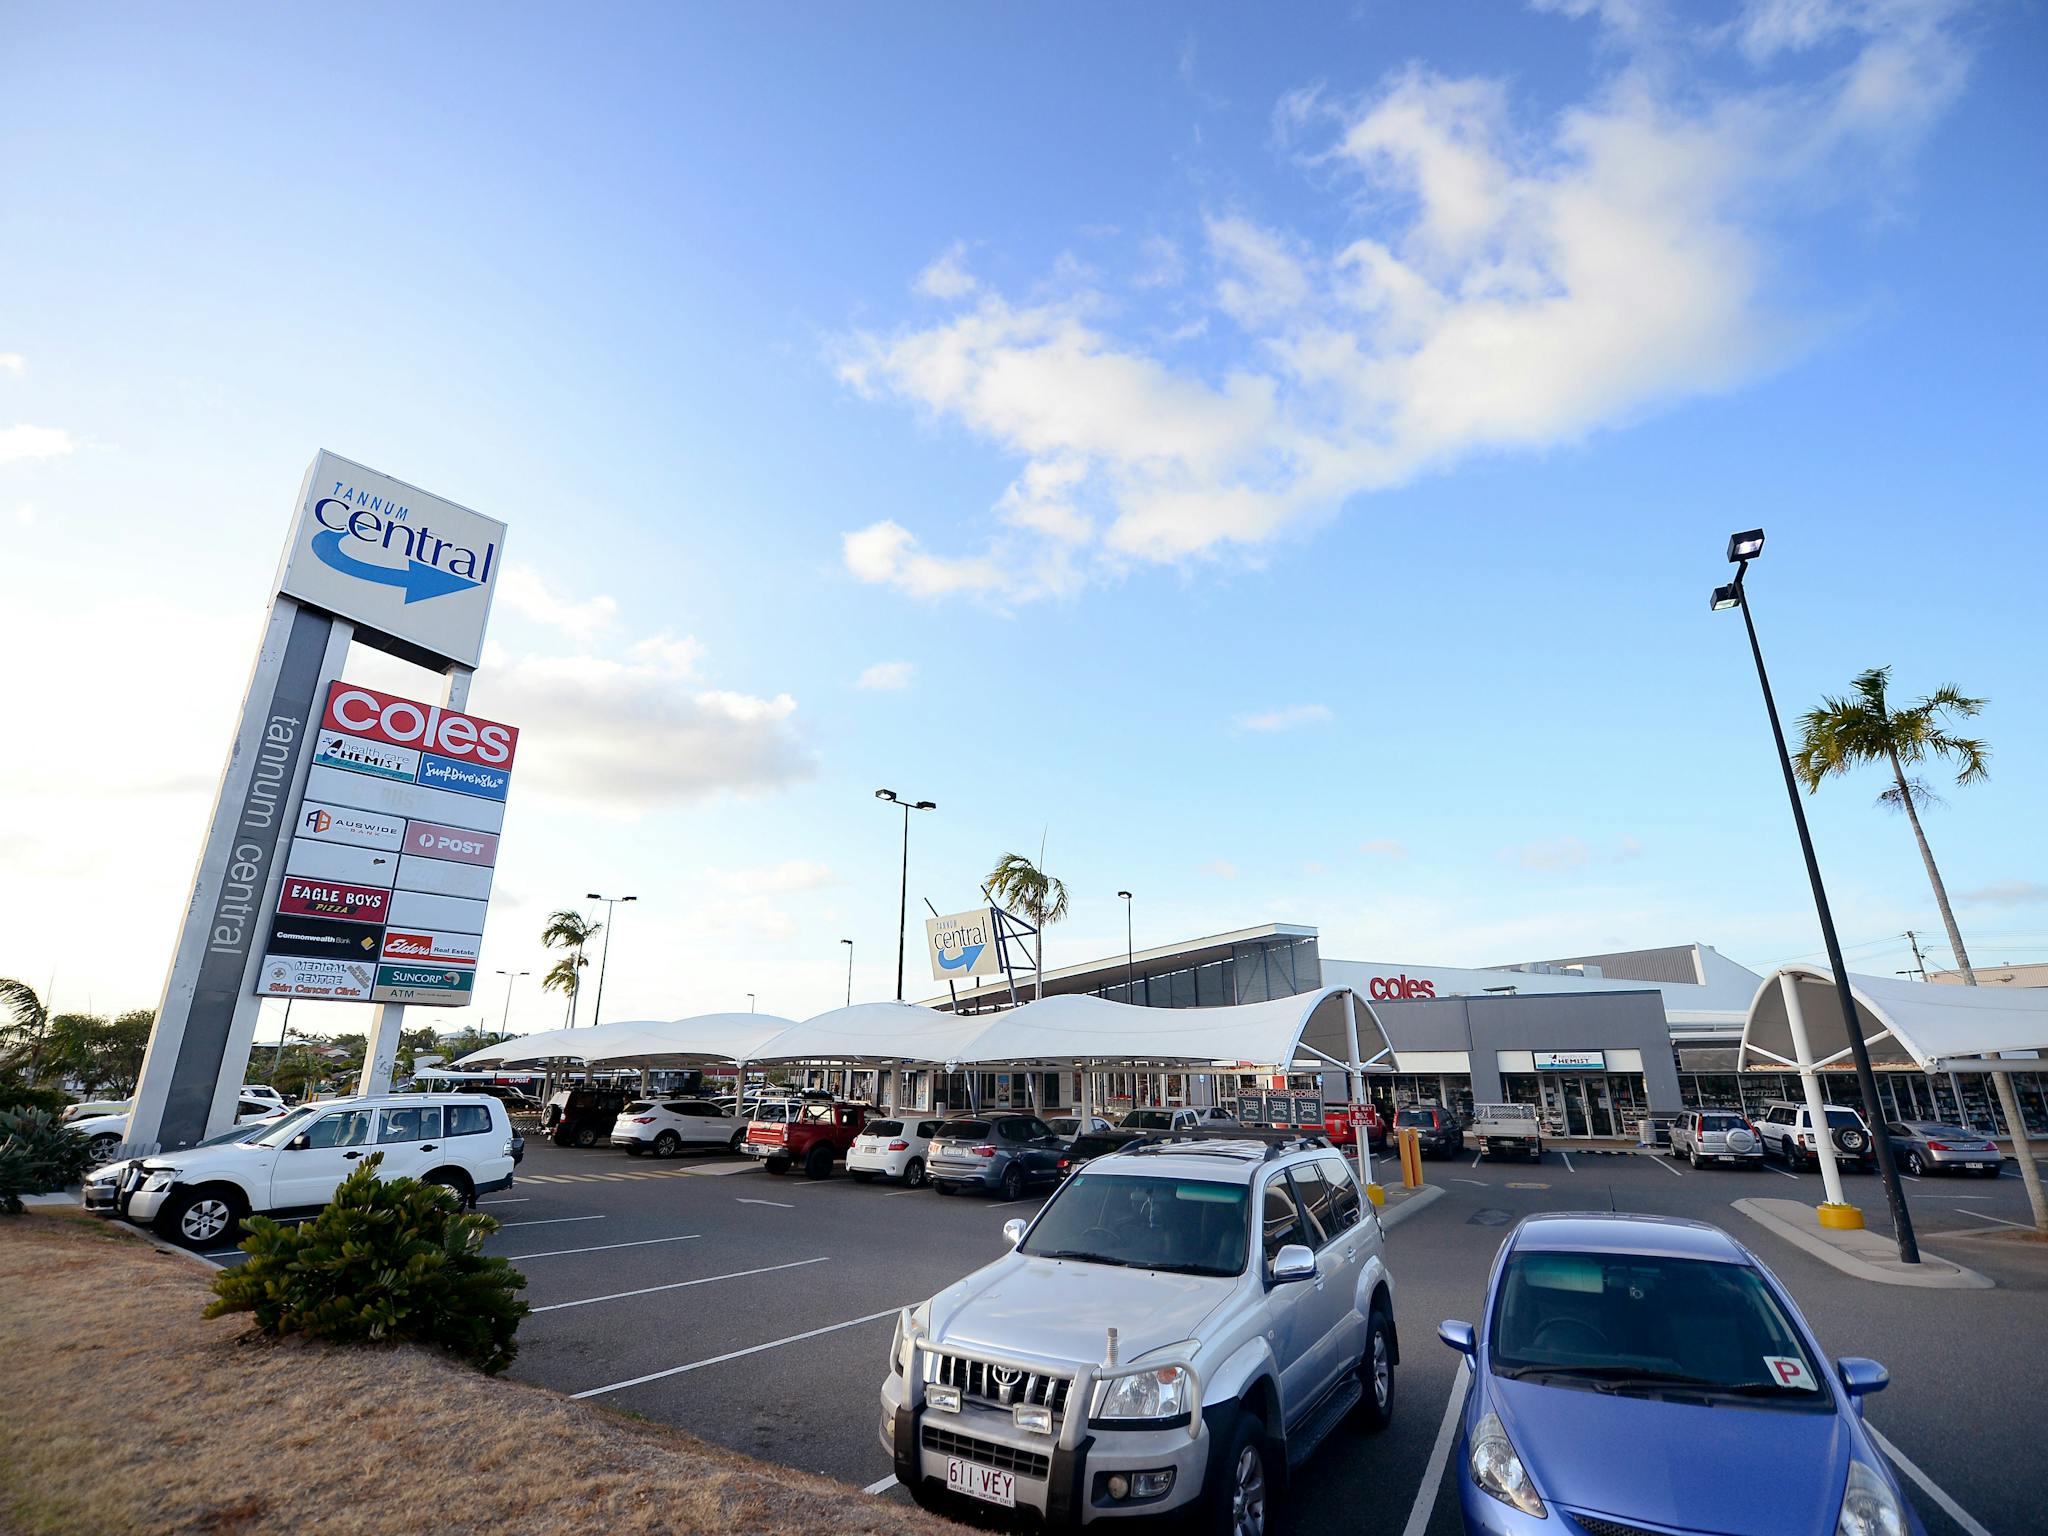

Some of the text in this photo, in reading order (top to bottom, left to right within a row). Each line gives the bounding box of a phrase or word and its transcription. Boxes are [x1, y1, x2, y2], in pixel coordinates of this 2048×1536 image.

[333, 481, 409, 521] TANNUM
[314, 498, 495, 583] central
[332, 690, 511, 763] coles
[343, 741, 410, 764] health care
[210, 714, 300, 954] tannum central
[335, 820, 397, 835] AUSWIDE
[438, 836, 485, 855] POST
[291, 884, 382, 908] EAGLE BOYS
[315, 903, 349, 913] PIZZA
[934, 916, 987, 950] central
[385, 938, 430, 955] Elders
[295, 961, 347, 974] MEDICAL
[392, 971, 442, 983] SUNCORP
[295, 973, 344, 985] CENTRE
[1370, 974, 1436, 1000] coles
[269, 983, 361, 996] Skin Cancer Clinic
[390, 989, 415, 998] ATM
[1295, 1090, 1320, 1098] coles
[1773, 1360, 1800, 1384] P
